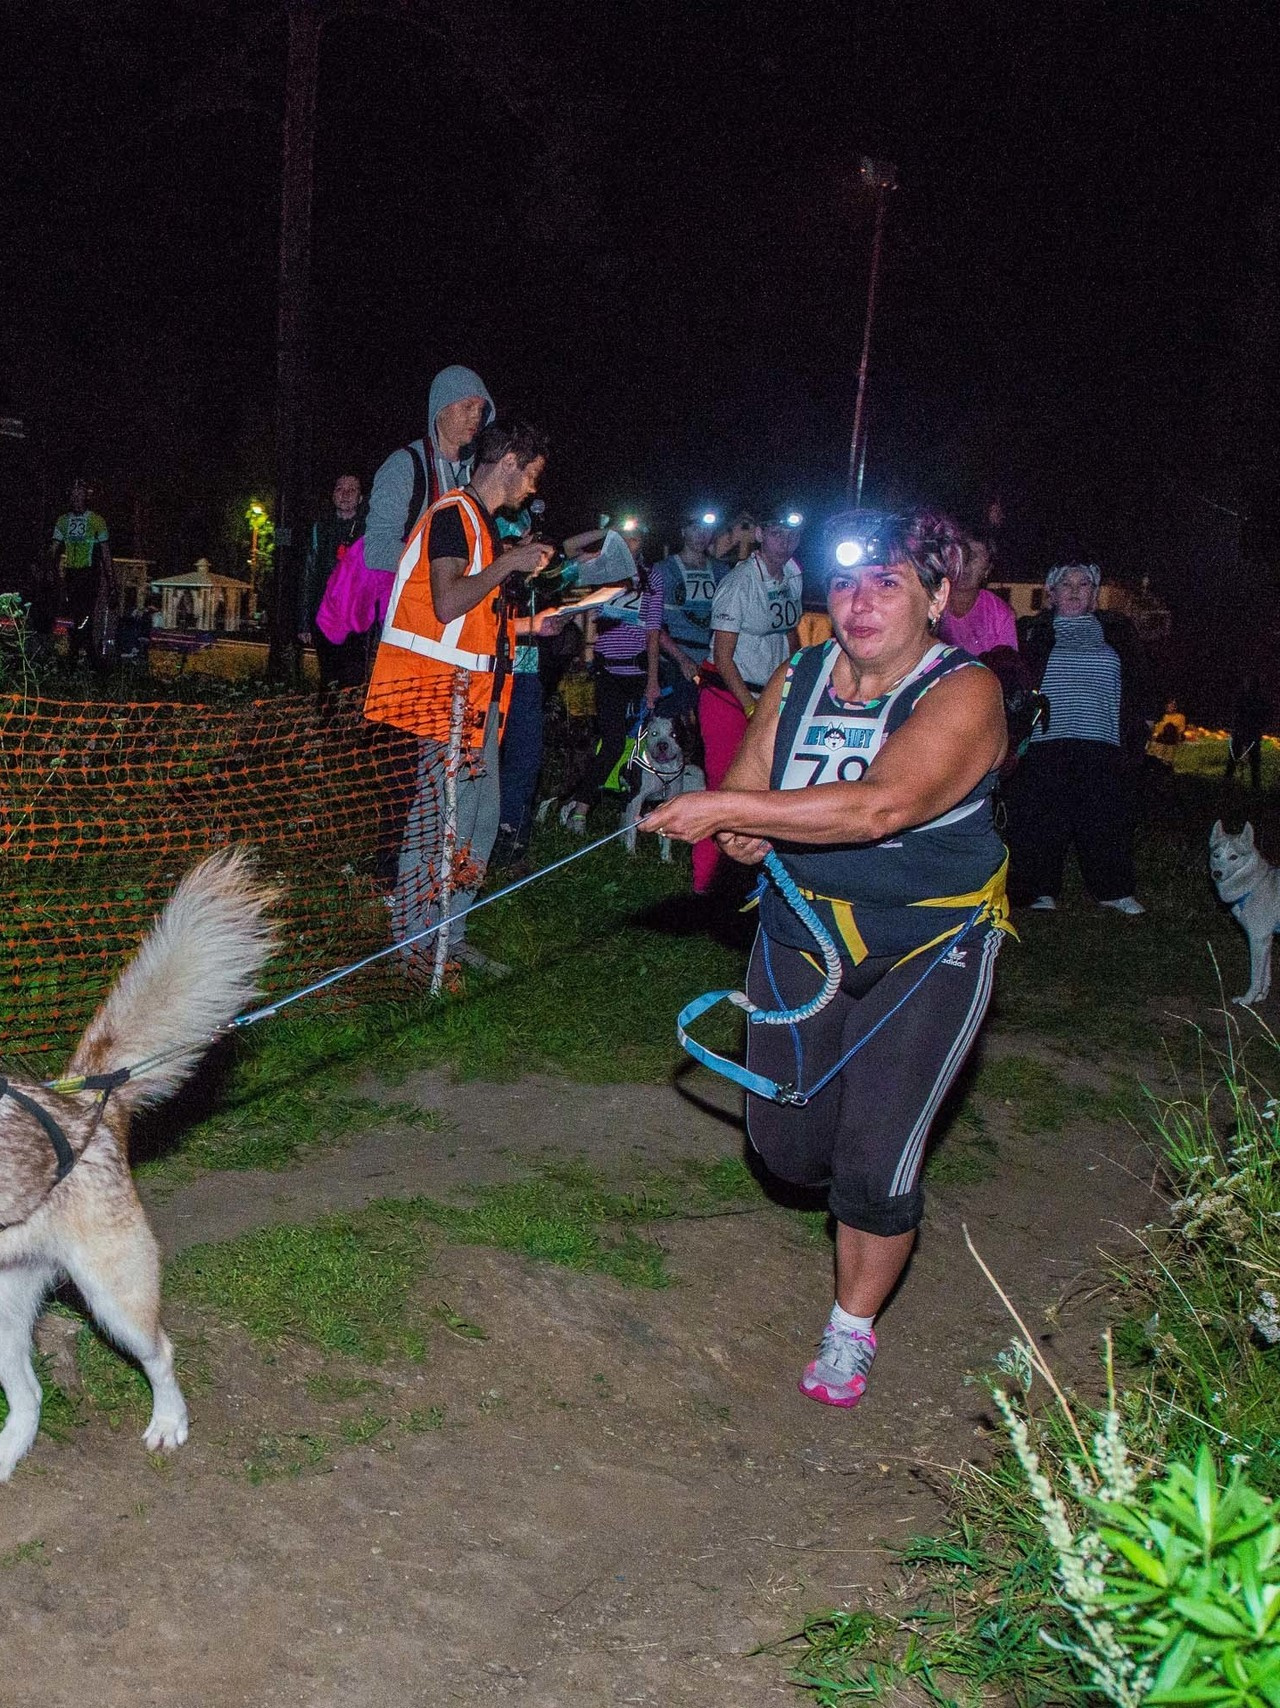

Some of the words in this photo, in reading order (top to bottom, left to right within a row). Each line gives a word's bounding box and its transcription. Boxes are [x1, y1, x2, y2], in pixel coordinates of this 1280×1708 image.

[69, 522, 86, 537] 23
[686, 580, 716, 600] 70
[770, 600, 797, 629] 30
[843, 727, 876, 749] HEY
[941, 958, 966, 969] adidas
